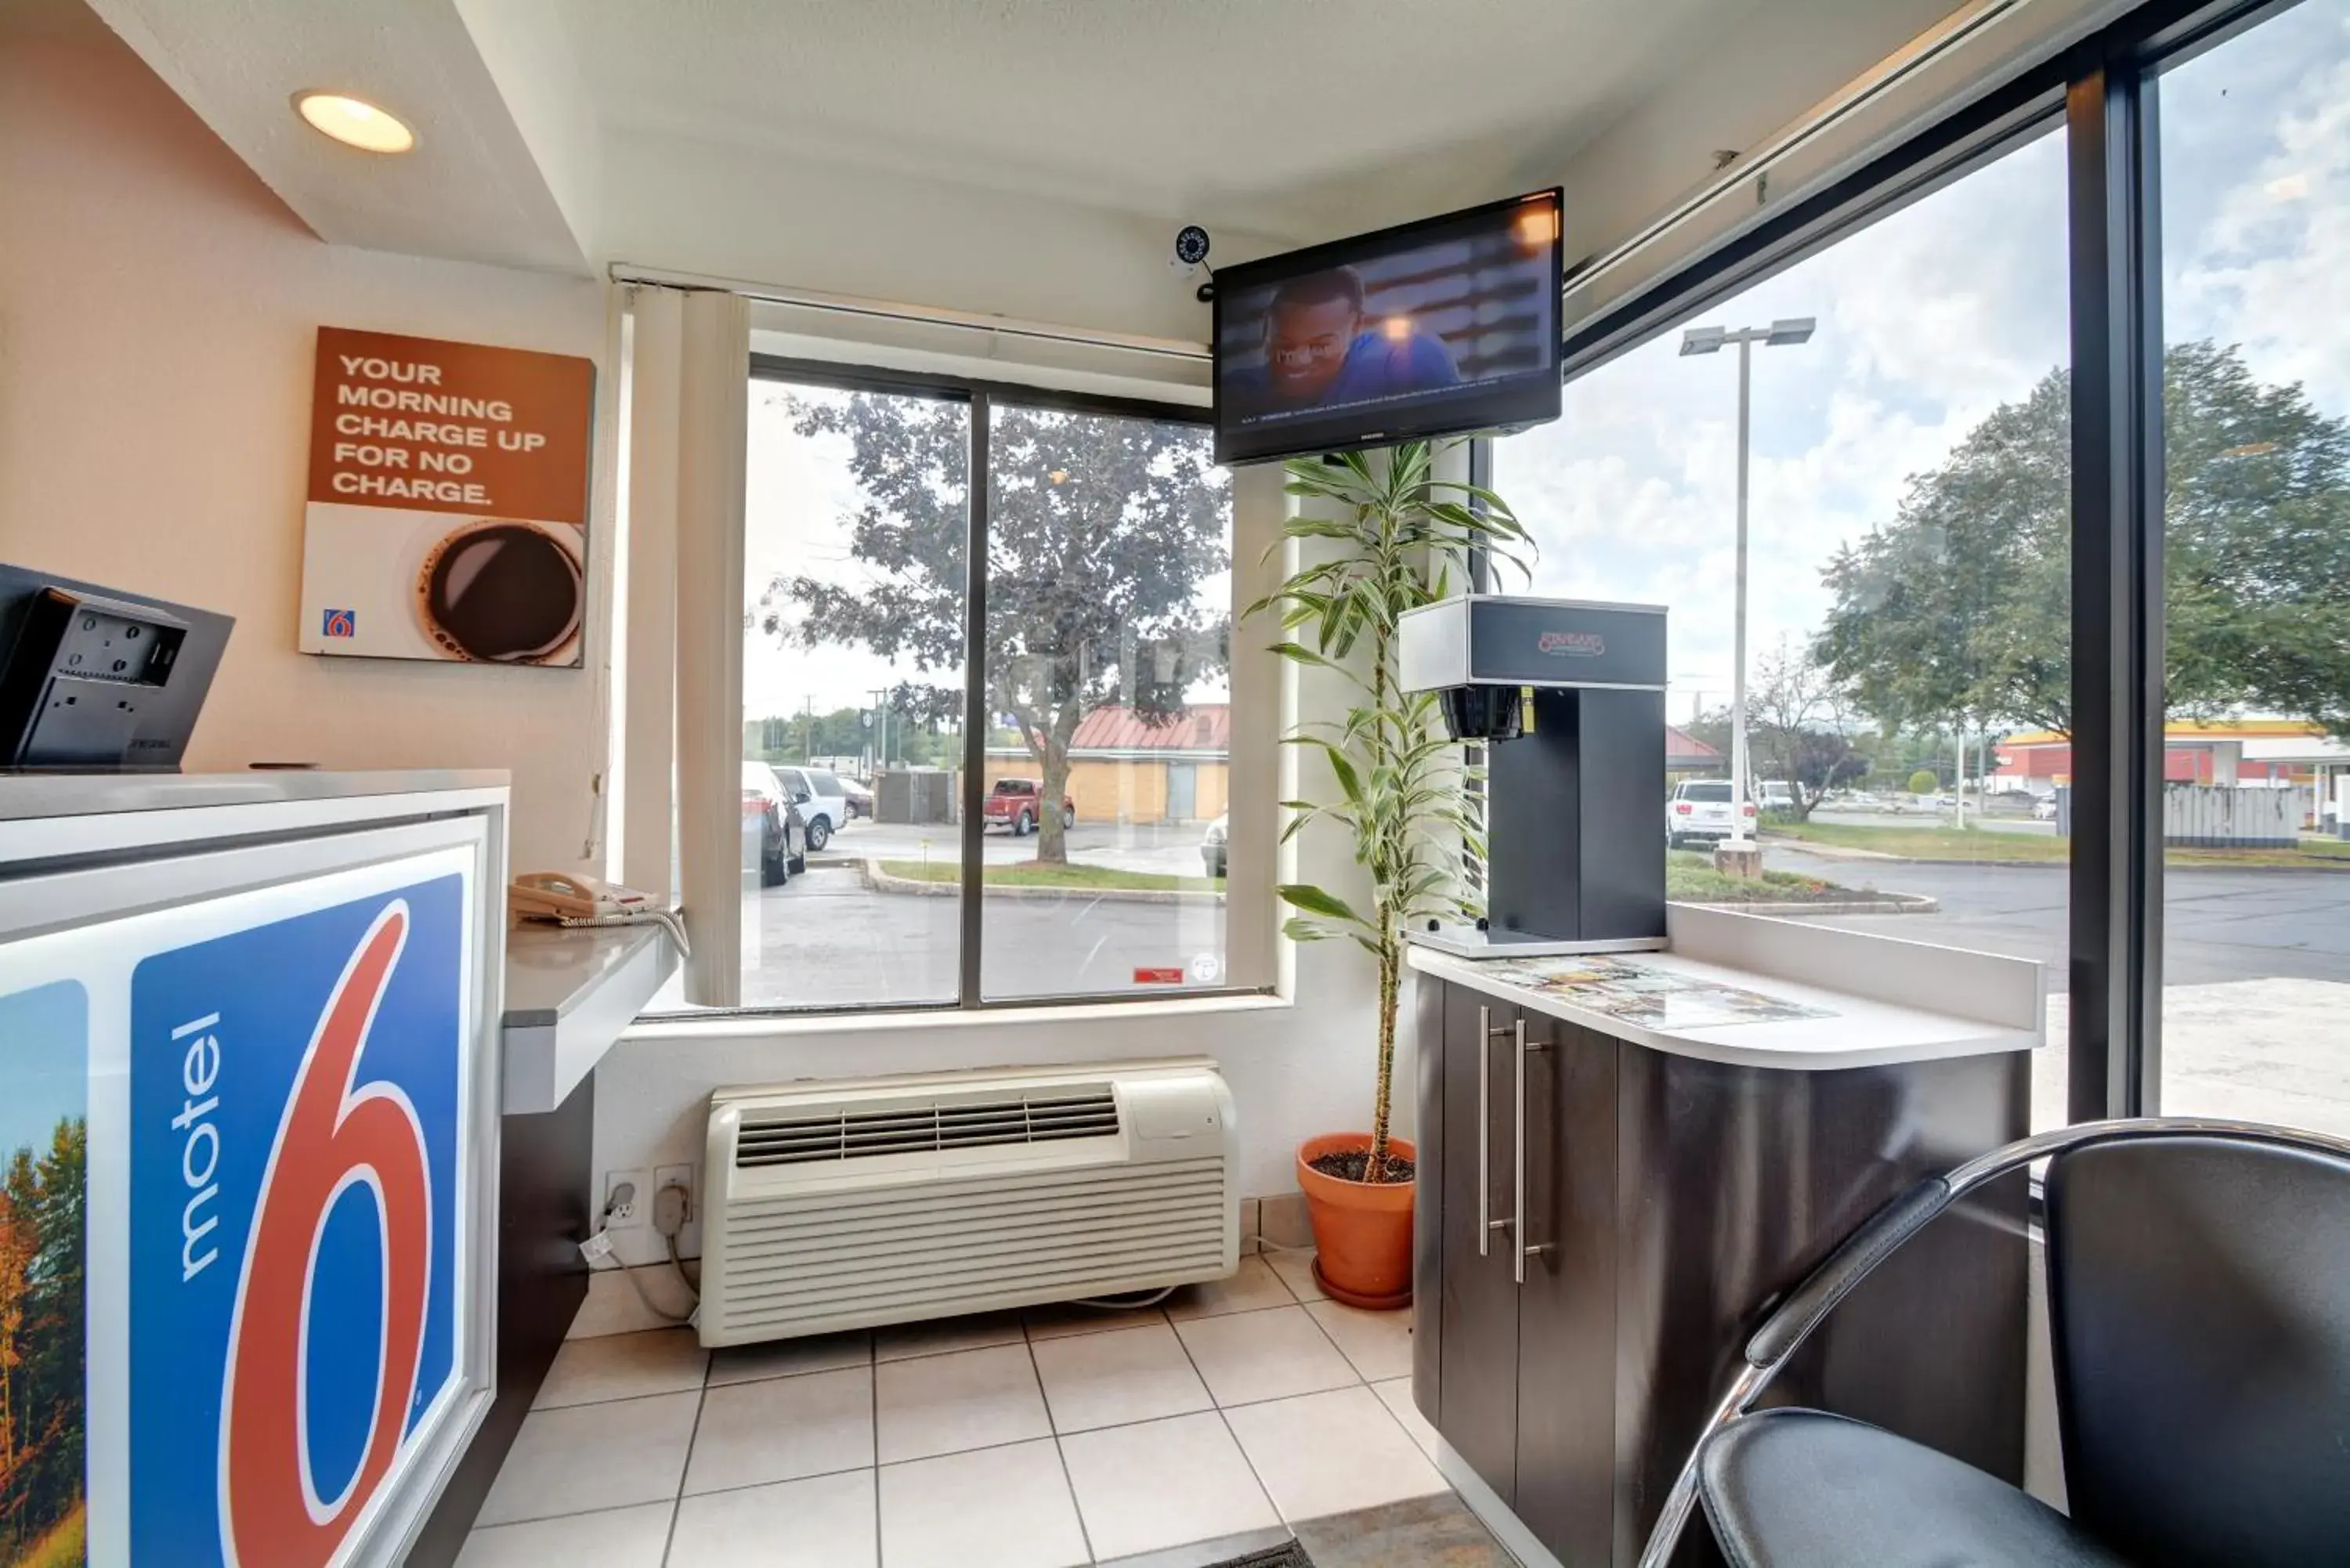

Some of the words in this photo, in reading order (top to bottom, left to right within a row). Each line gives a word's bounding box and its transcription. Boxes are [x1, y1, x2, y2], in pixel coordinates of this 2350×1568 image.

[338, 355, 441, 385] YOUR
[338, 385, 513, 422] MORNING
[335, 414, 487, 448] CHARGE
[497, 430, 546, 452] UP
[334, 443, 409, 469] FOR
[419, 453, 473, 475] NO
[332, 471, 493, 505] CHARGE.
[327, 609, 352, 638] 6
[172, 1012, 221, 1283] motel
[217, 898, 433, 1568] 6
